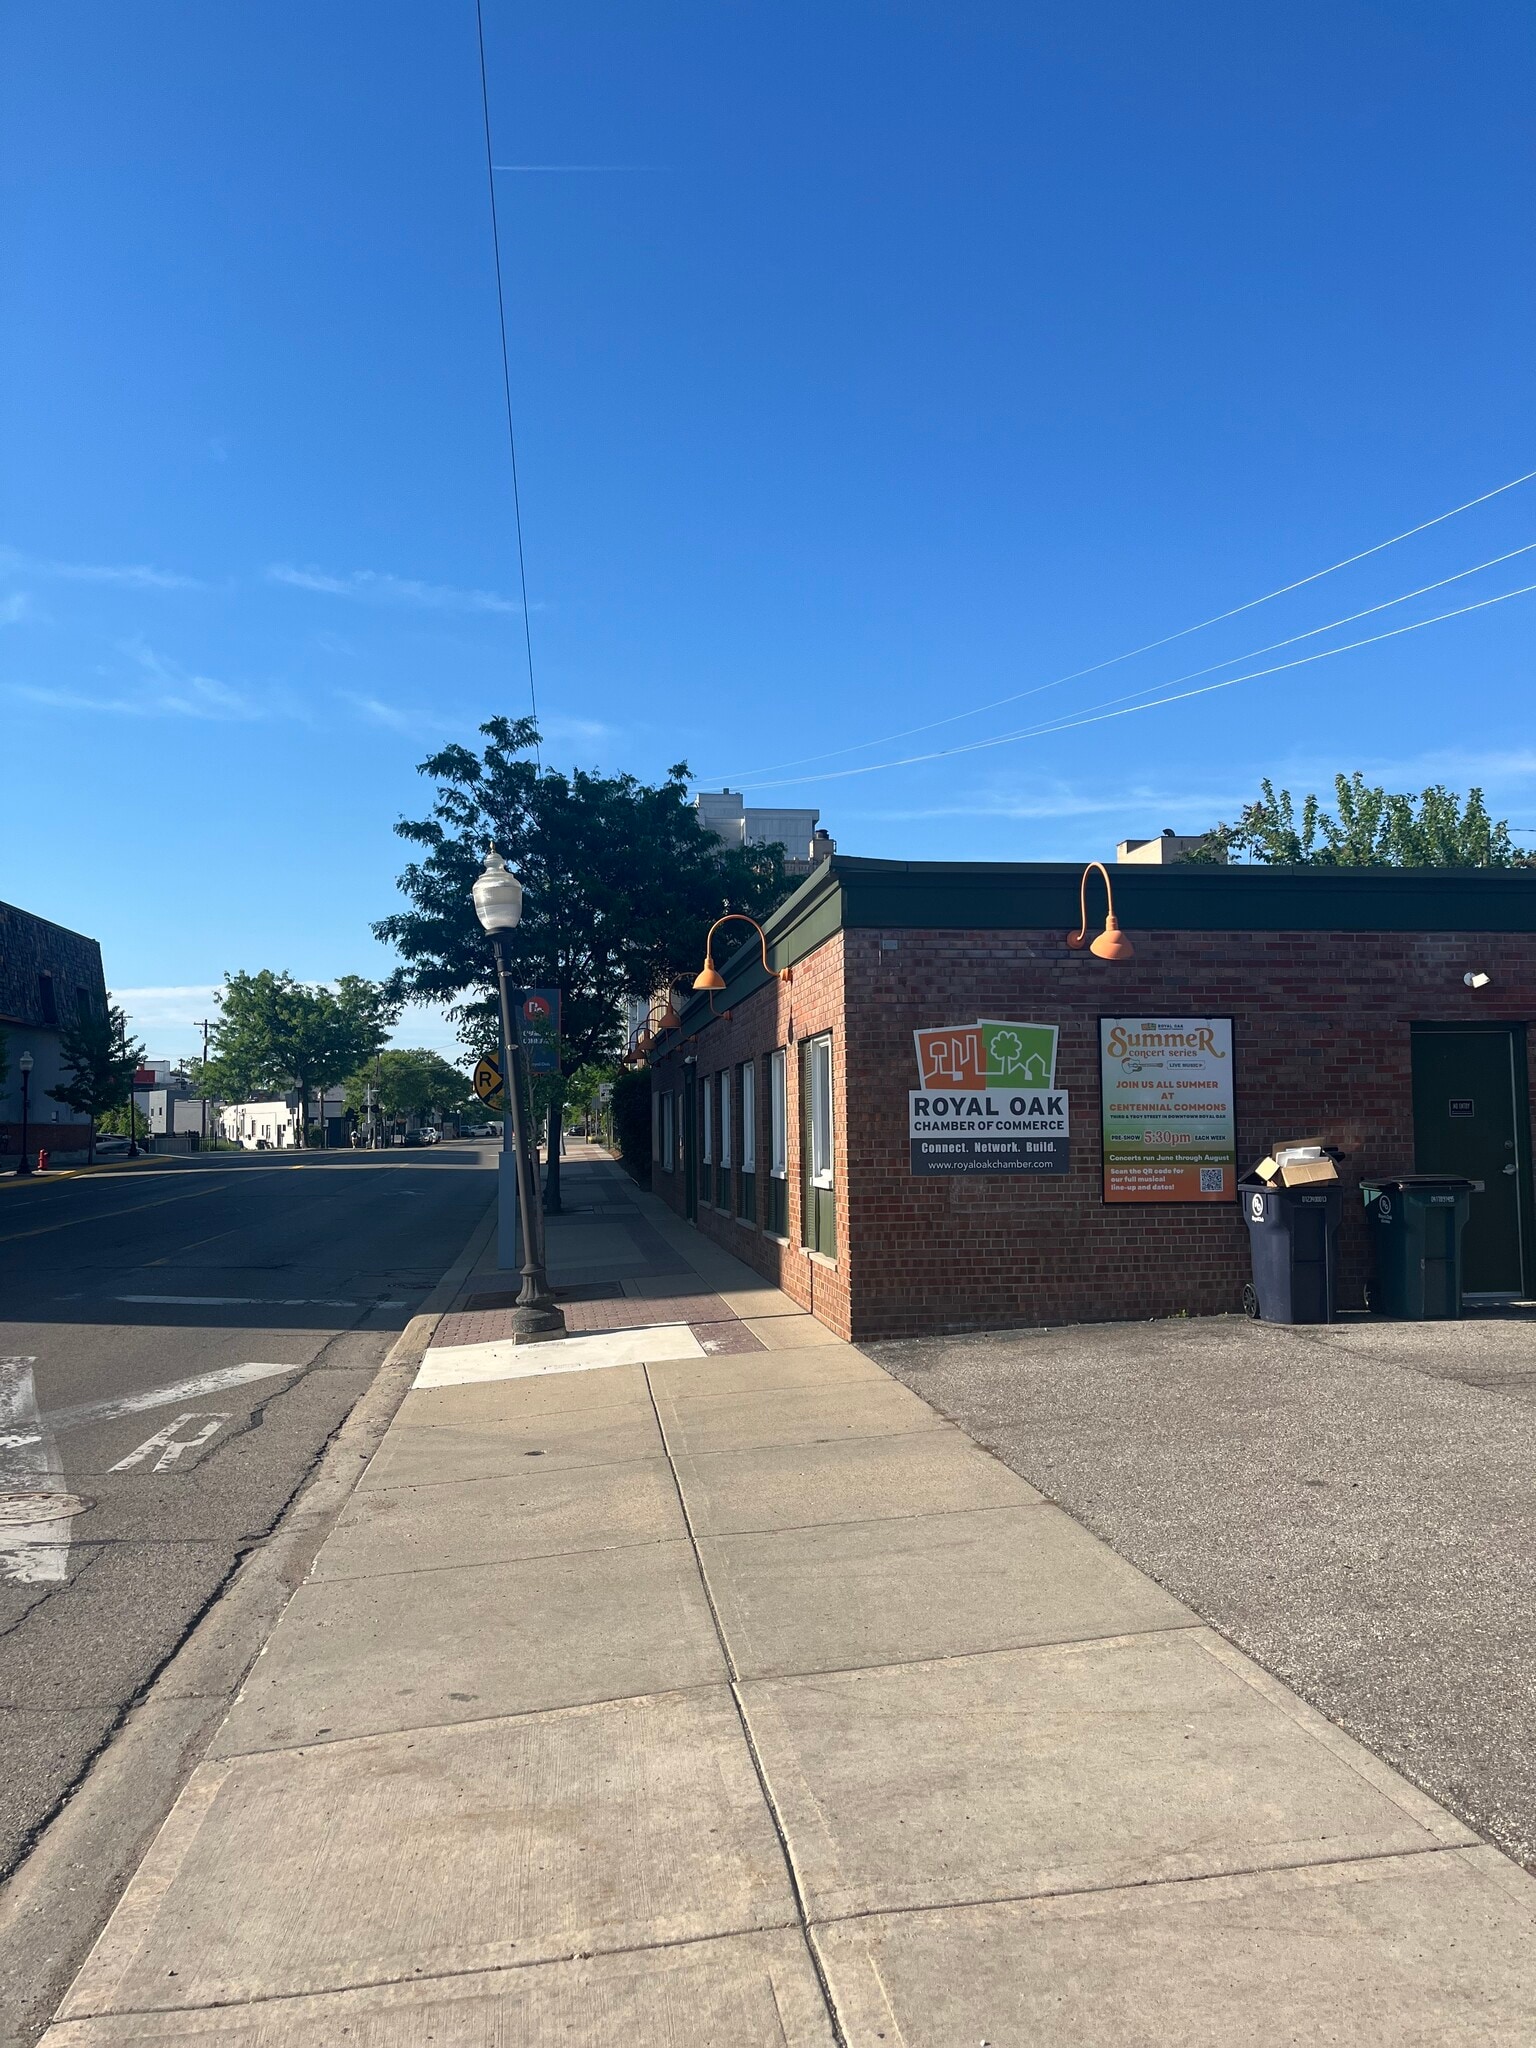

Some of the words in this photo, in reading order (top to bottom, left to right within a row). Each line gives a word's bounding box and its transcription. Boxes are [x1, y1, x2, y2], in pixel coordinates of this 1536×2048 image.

[1129, 1049, 1165, 1058] concert
[1168, 1049, 1197, 1057] series
[480, 1072, 491, 1087] R
[914, 1098, 999, 1116] ROYAL
[1010, 1097, 1064, 1116] OAK
[914, 1122, 975, 1131] CHAMBER
[978, 1121, 994, 1130] OF
[996, 1120, 1064, 1130] COMMERCE
[1144, 1131, 1191, 1145] 5:30pm
[922, 1142, 969, 1153] Connect.
[975, 1142, 1020, 1152] Network.
[1026, 1142, 1056, 1152] Build.
[928, 1159, 1053, 1171] www.royaloakchamber.com
